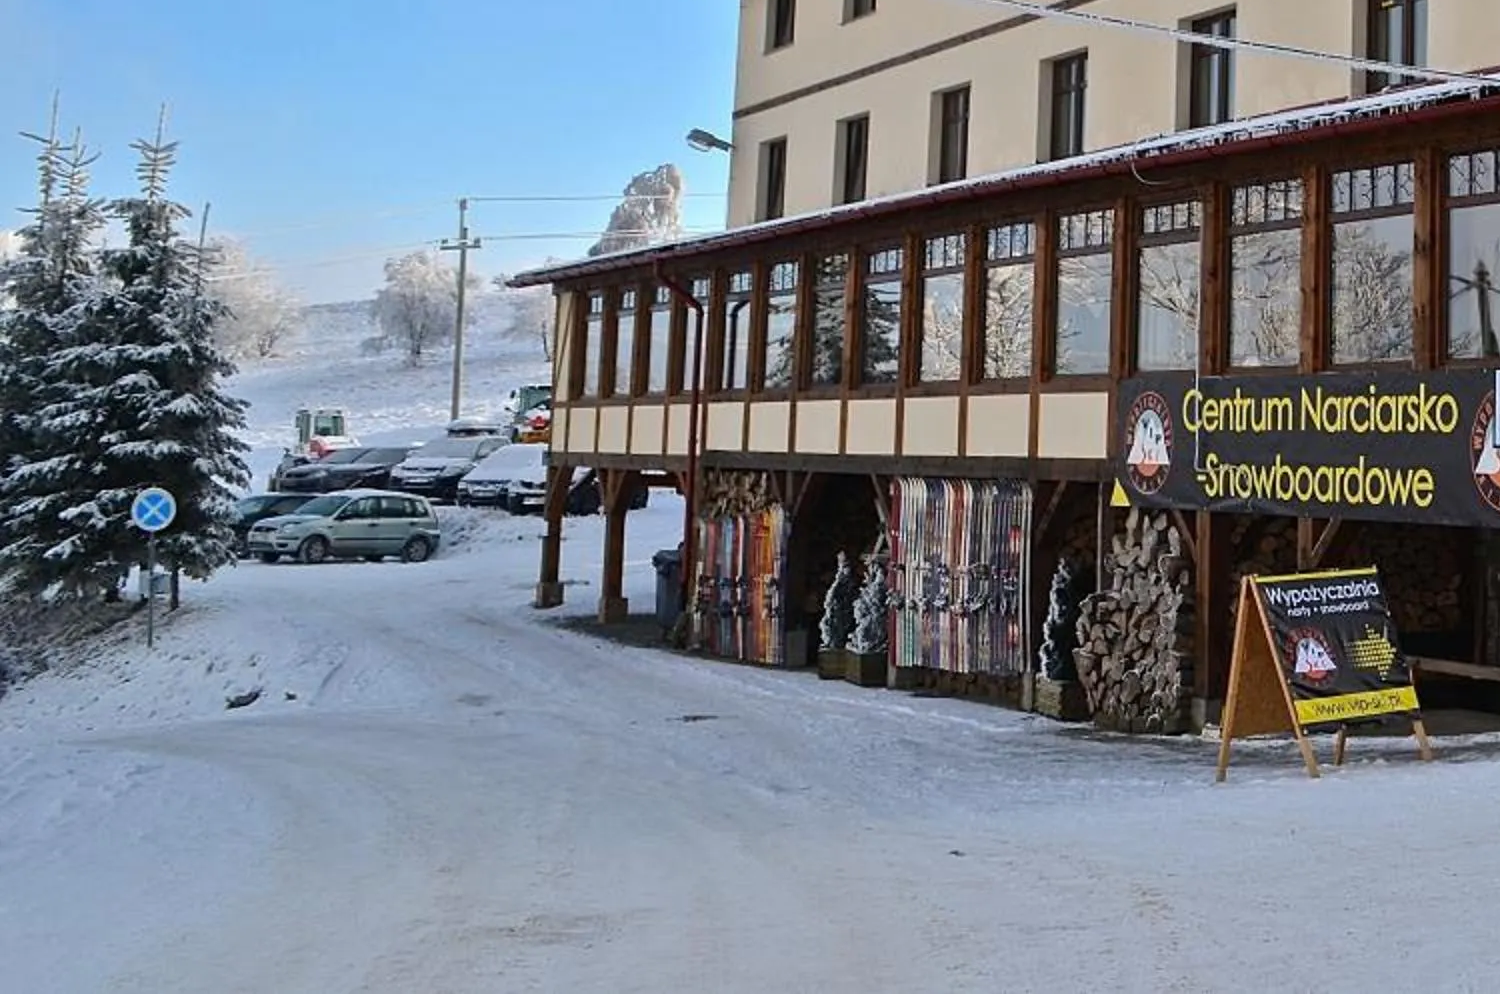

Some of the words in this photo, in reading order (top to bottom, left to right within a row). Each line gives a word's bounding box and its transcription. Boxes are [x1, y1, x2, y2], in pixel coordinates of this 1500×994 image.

[1182, 387, 1293, 432] Centrum
[1301, 383, 1459, 433] Narciarsko
[1265, 579, 1380, 607] Wypożyczalnia
